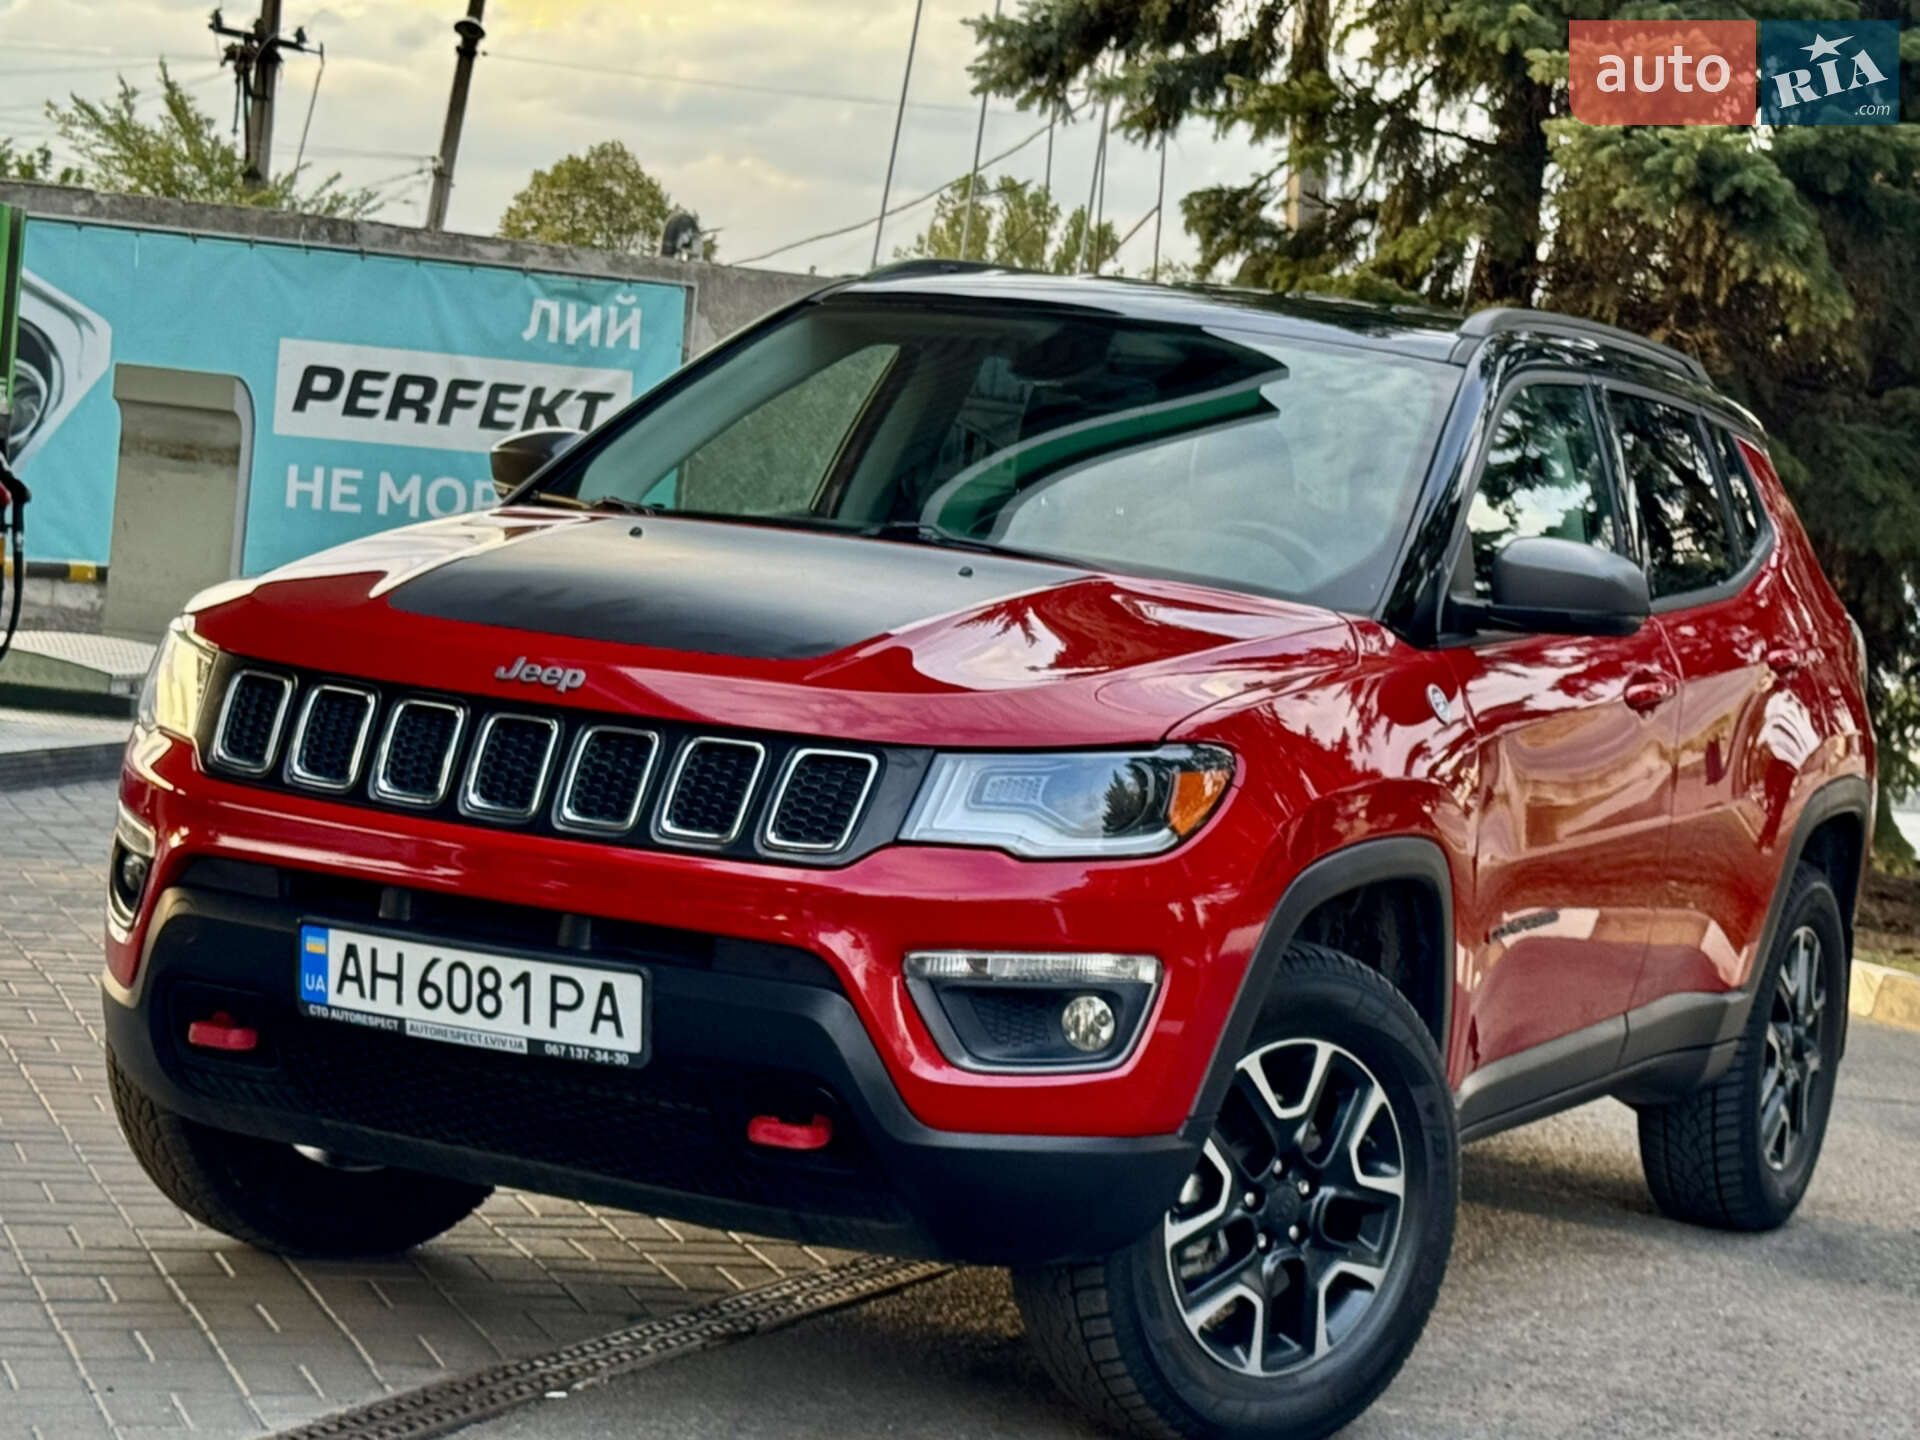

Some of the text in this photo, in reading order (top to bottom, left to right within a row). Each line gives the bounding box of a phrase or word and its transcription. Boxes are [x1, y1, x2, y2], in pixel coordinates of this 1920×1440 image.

[521, 293, 642, 350] ЛИЙ
[291, 363, 616, 432] PERFEKT
[285, 464, 364, 512] НЕ
[494, 655, 587, 693] Jeep
[304, 973, 327, 994] UA
[336, 942, 625, 1039] AH 6081 PA
[330, 1009, 399, 1031] AUTORESPECT
[544, 1042, 566, 1058] 067
